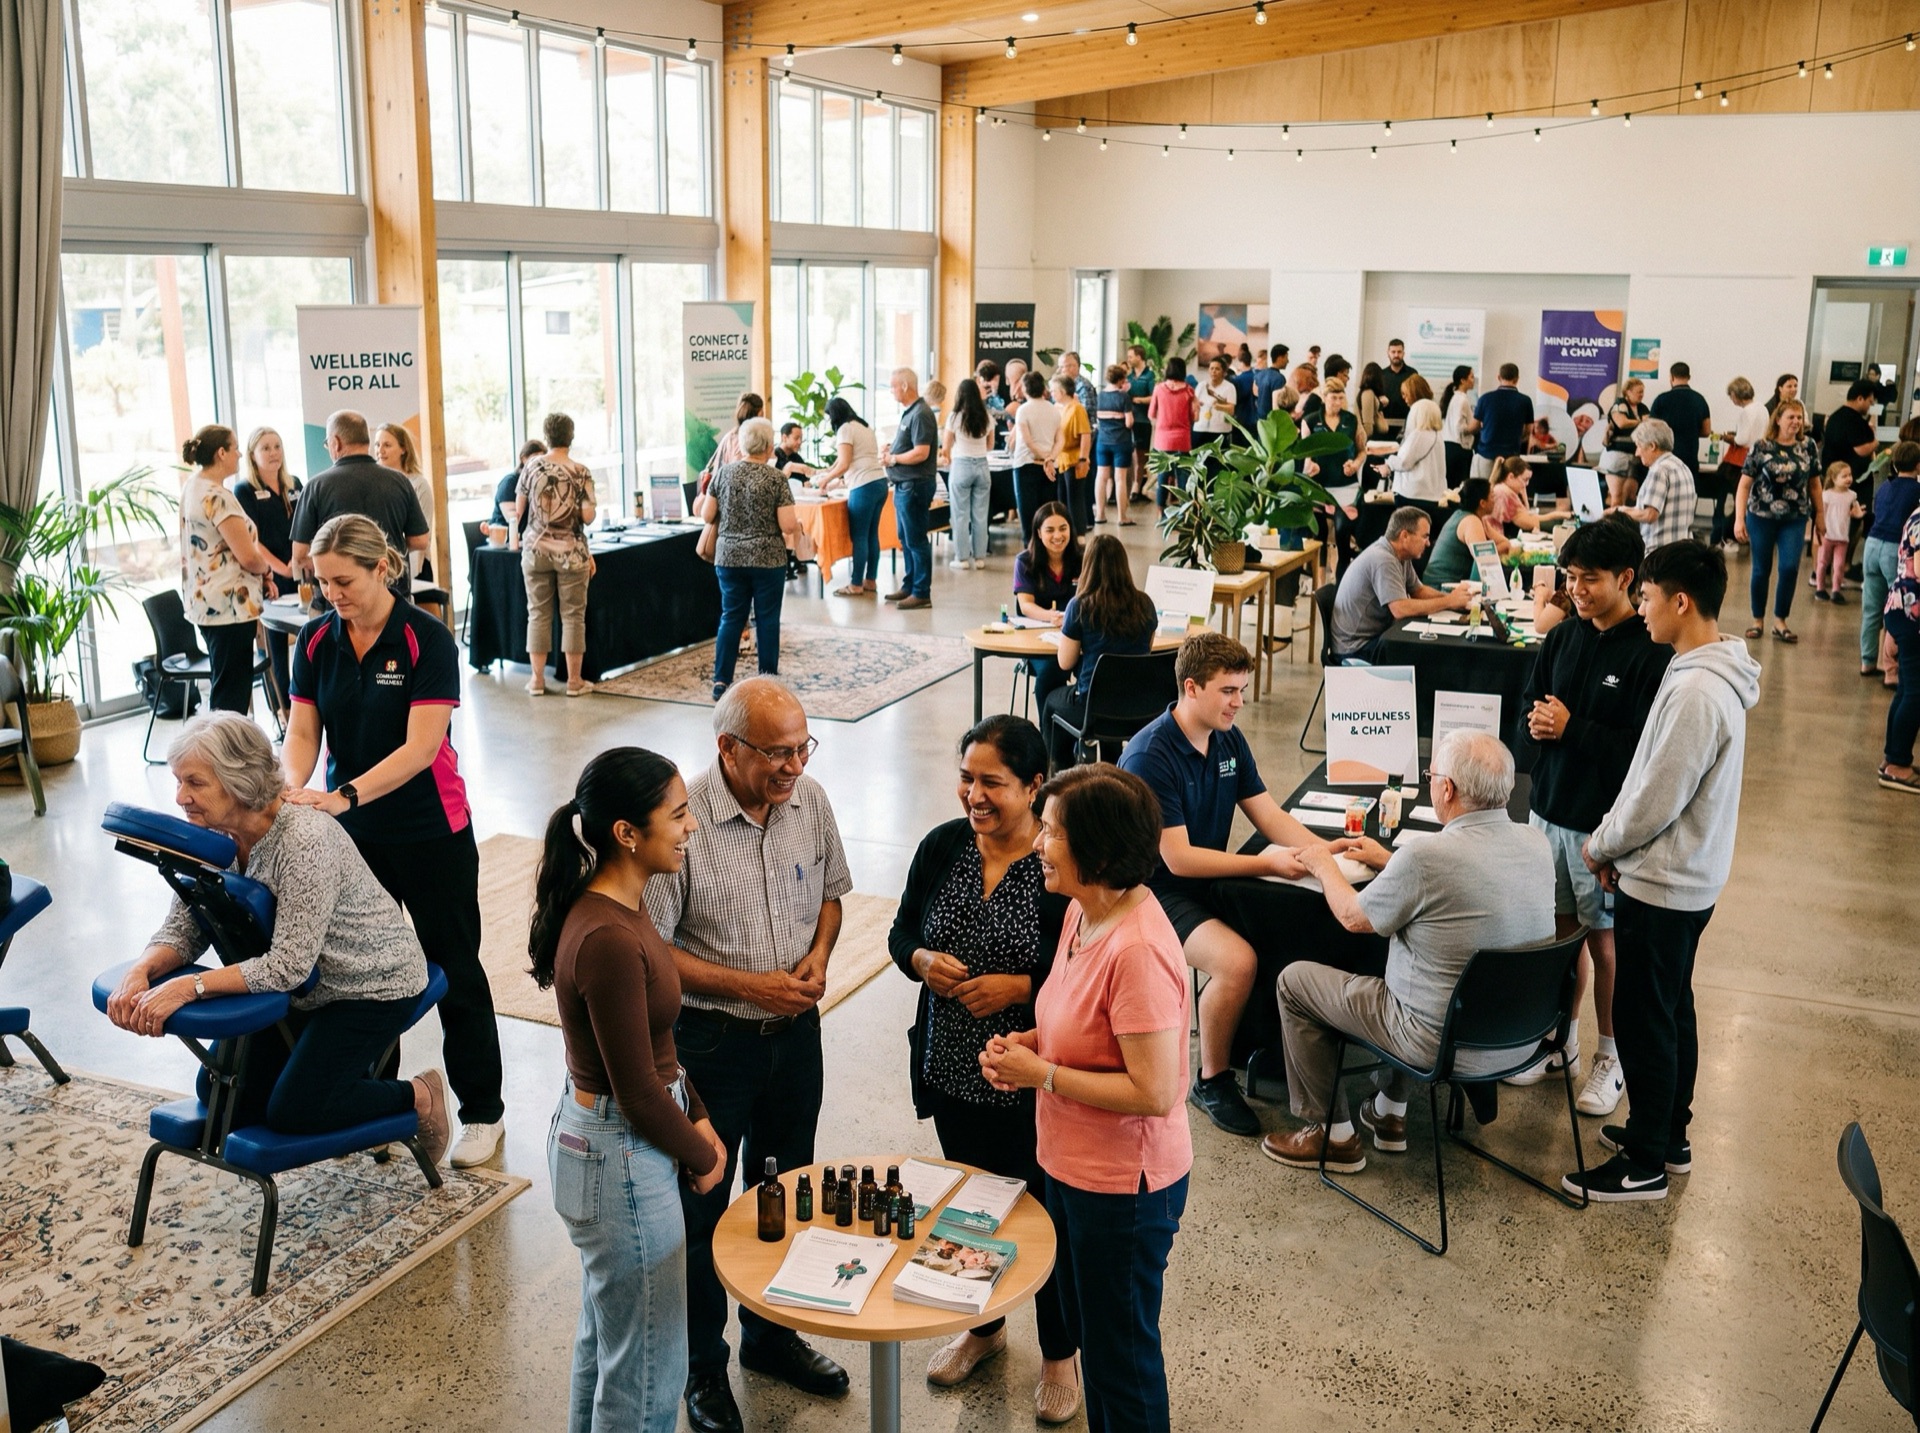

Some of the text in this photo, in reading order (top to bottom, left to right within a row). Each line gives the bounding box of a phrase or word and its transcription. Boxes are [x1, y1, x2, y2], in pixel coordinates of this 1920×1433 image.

[689, 334, 749, 347] CONNECT &
[1544, 337, 1617, 348] MINDFULNESS
[691, 349, 748, 362] RECHARGE
[1560, 348, 1599, 358] & CHAT
[310, 352, 413, 370] WELLBEING
[328, 374, 400, 391] FOR ALL
[1331, 711, 1411, 722] MINDFULNESS
[1350, 725, 1392, 735] & CHAT
